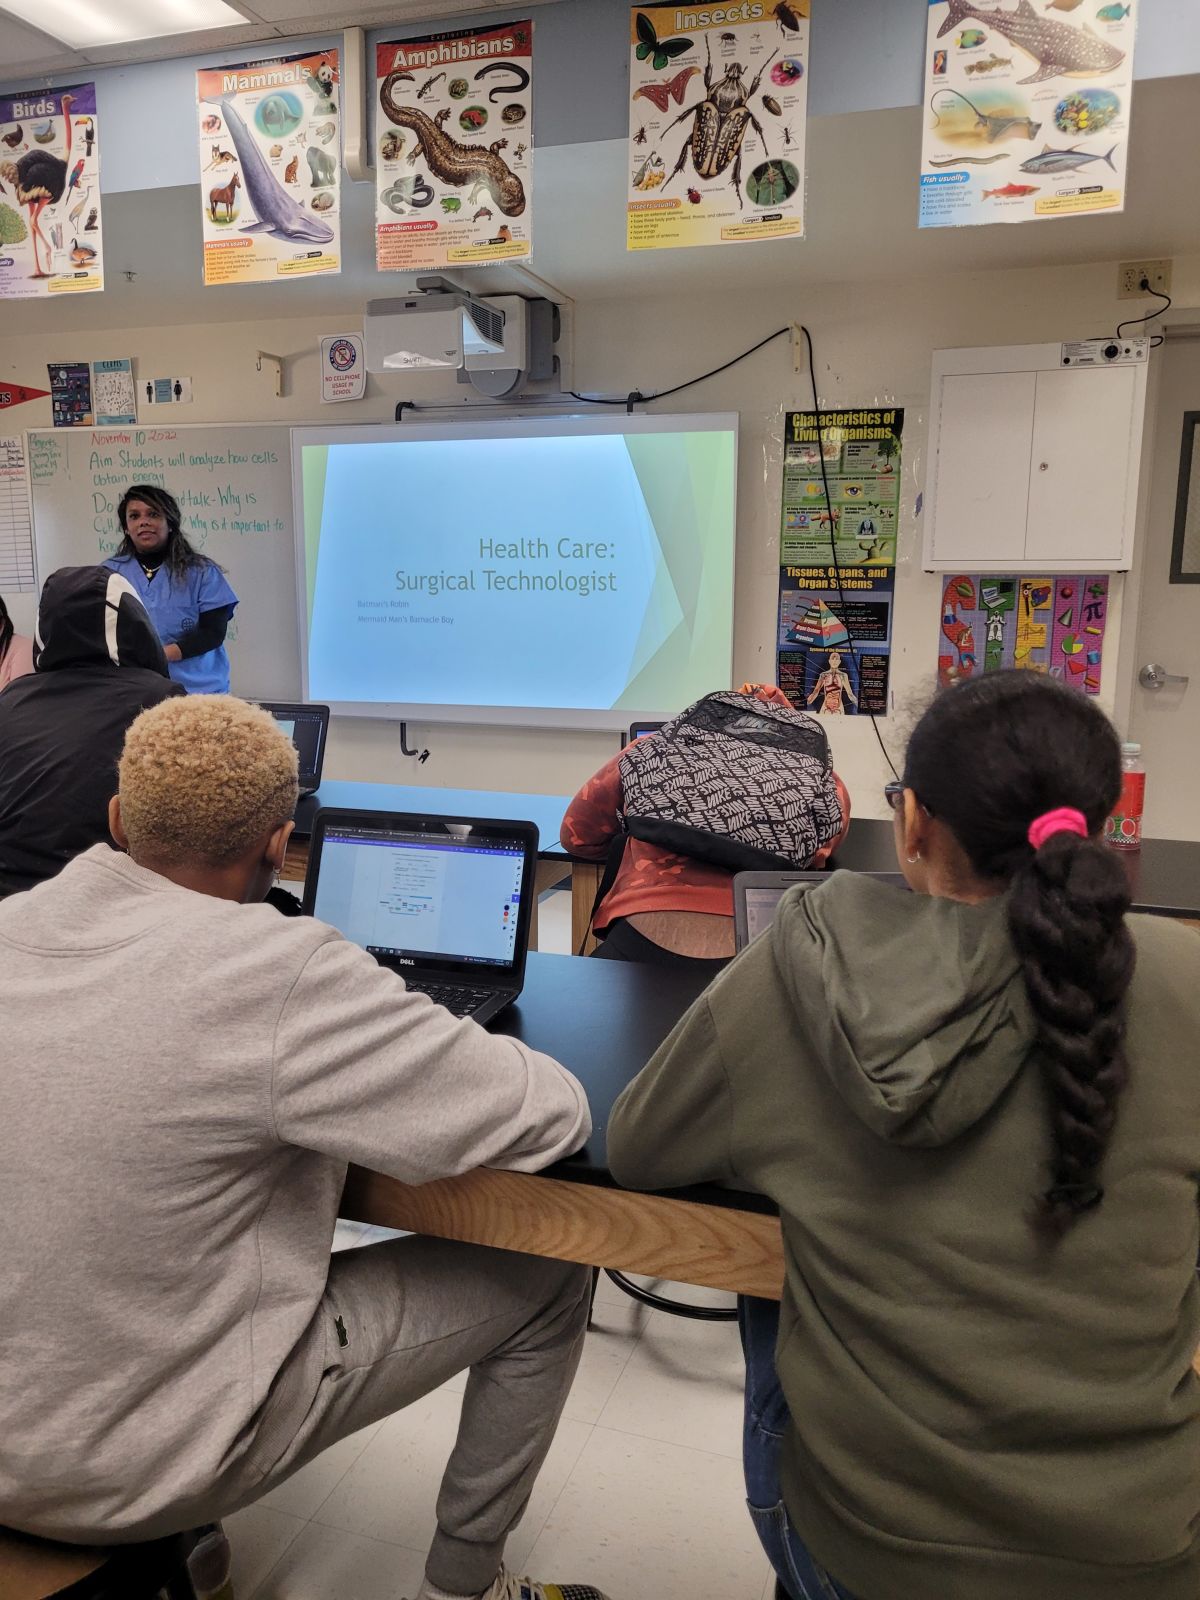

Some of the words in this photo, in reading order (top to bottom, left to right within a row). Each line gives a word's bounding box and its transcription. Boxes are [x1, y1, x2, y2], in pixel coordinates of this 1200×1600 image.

[676, 2, 763, 30] Insects
[430, 30, 474, 40] Exploring
[393, 37, 514, 68] Amphibians
[224, 64, 312, 92] Mammals
[12, 100, 54, 118] Birds
[938, 174, 966, 184] usually:
[380, 224, 412, 232] Amphibians
[792, 412, 881, 427] Characteristics
[884, 410, 896, 424] of
[91, 432, 131, 447] November
[135, 431, 146, 446] 10
[148, 431, 178, 441] 2022
[794, 427, 828, 442] Living
[829, 426, 892, 441] Organisms
[90, 451, 112, 470] Aim
[119, 450, 164, 469] Students
[168, 452, 185, 467] will
[190, 453, 225, 472] analyze
[228, 449, 248, 464] how
[252, 451, 278, 464] cells
[93, 492, 113, 514] Do
[217, 485, 242, 515] Why
[246, 492, 257, 504] is
[190, 514, 208, 538] Why
[212, 519, 219, 530] is
[231, 520, 270, 536] important
[274, 518, 285, 530] to
[480, 538, 548, 559] Health
[558, 538, 615, 560] Care:
[786, 567, 826, 578] Tissues,
[868, 567, 888, 578] and
[396, 570, 476, 596] Surgical
[483, 570, 617, 596] Technologist
[799, 579, 828, 589] Organ
[358, 600, 388, 609] Batman's
[390, 600, 409, 609] Robin
[358, 616, 387, 624] Mermaid
[388, 615, 408, 624] Man's
[410, 616, 440, 624] Barnacle
[441, 616, 455, 626] Boy
